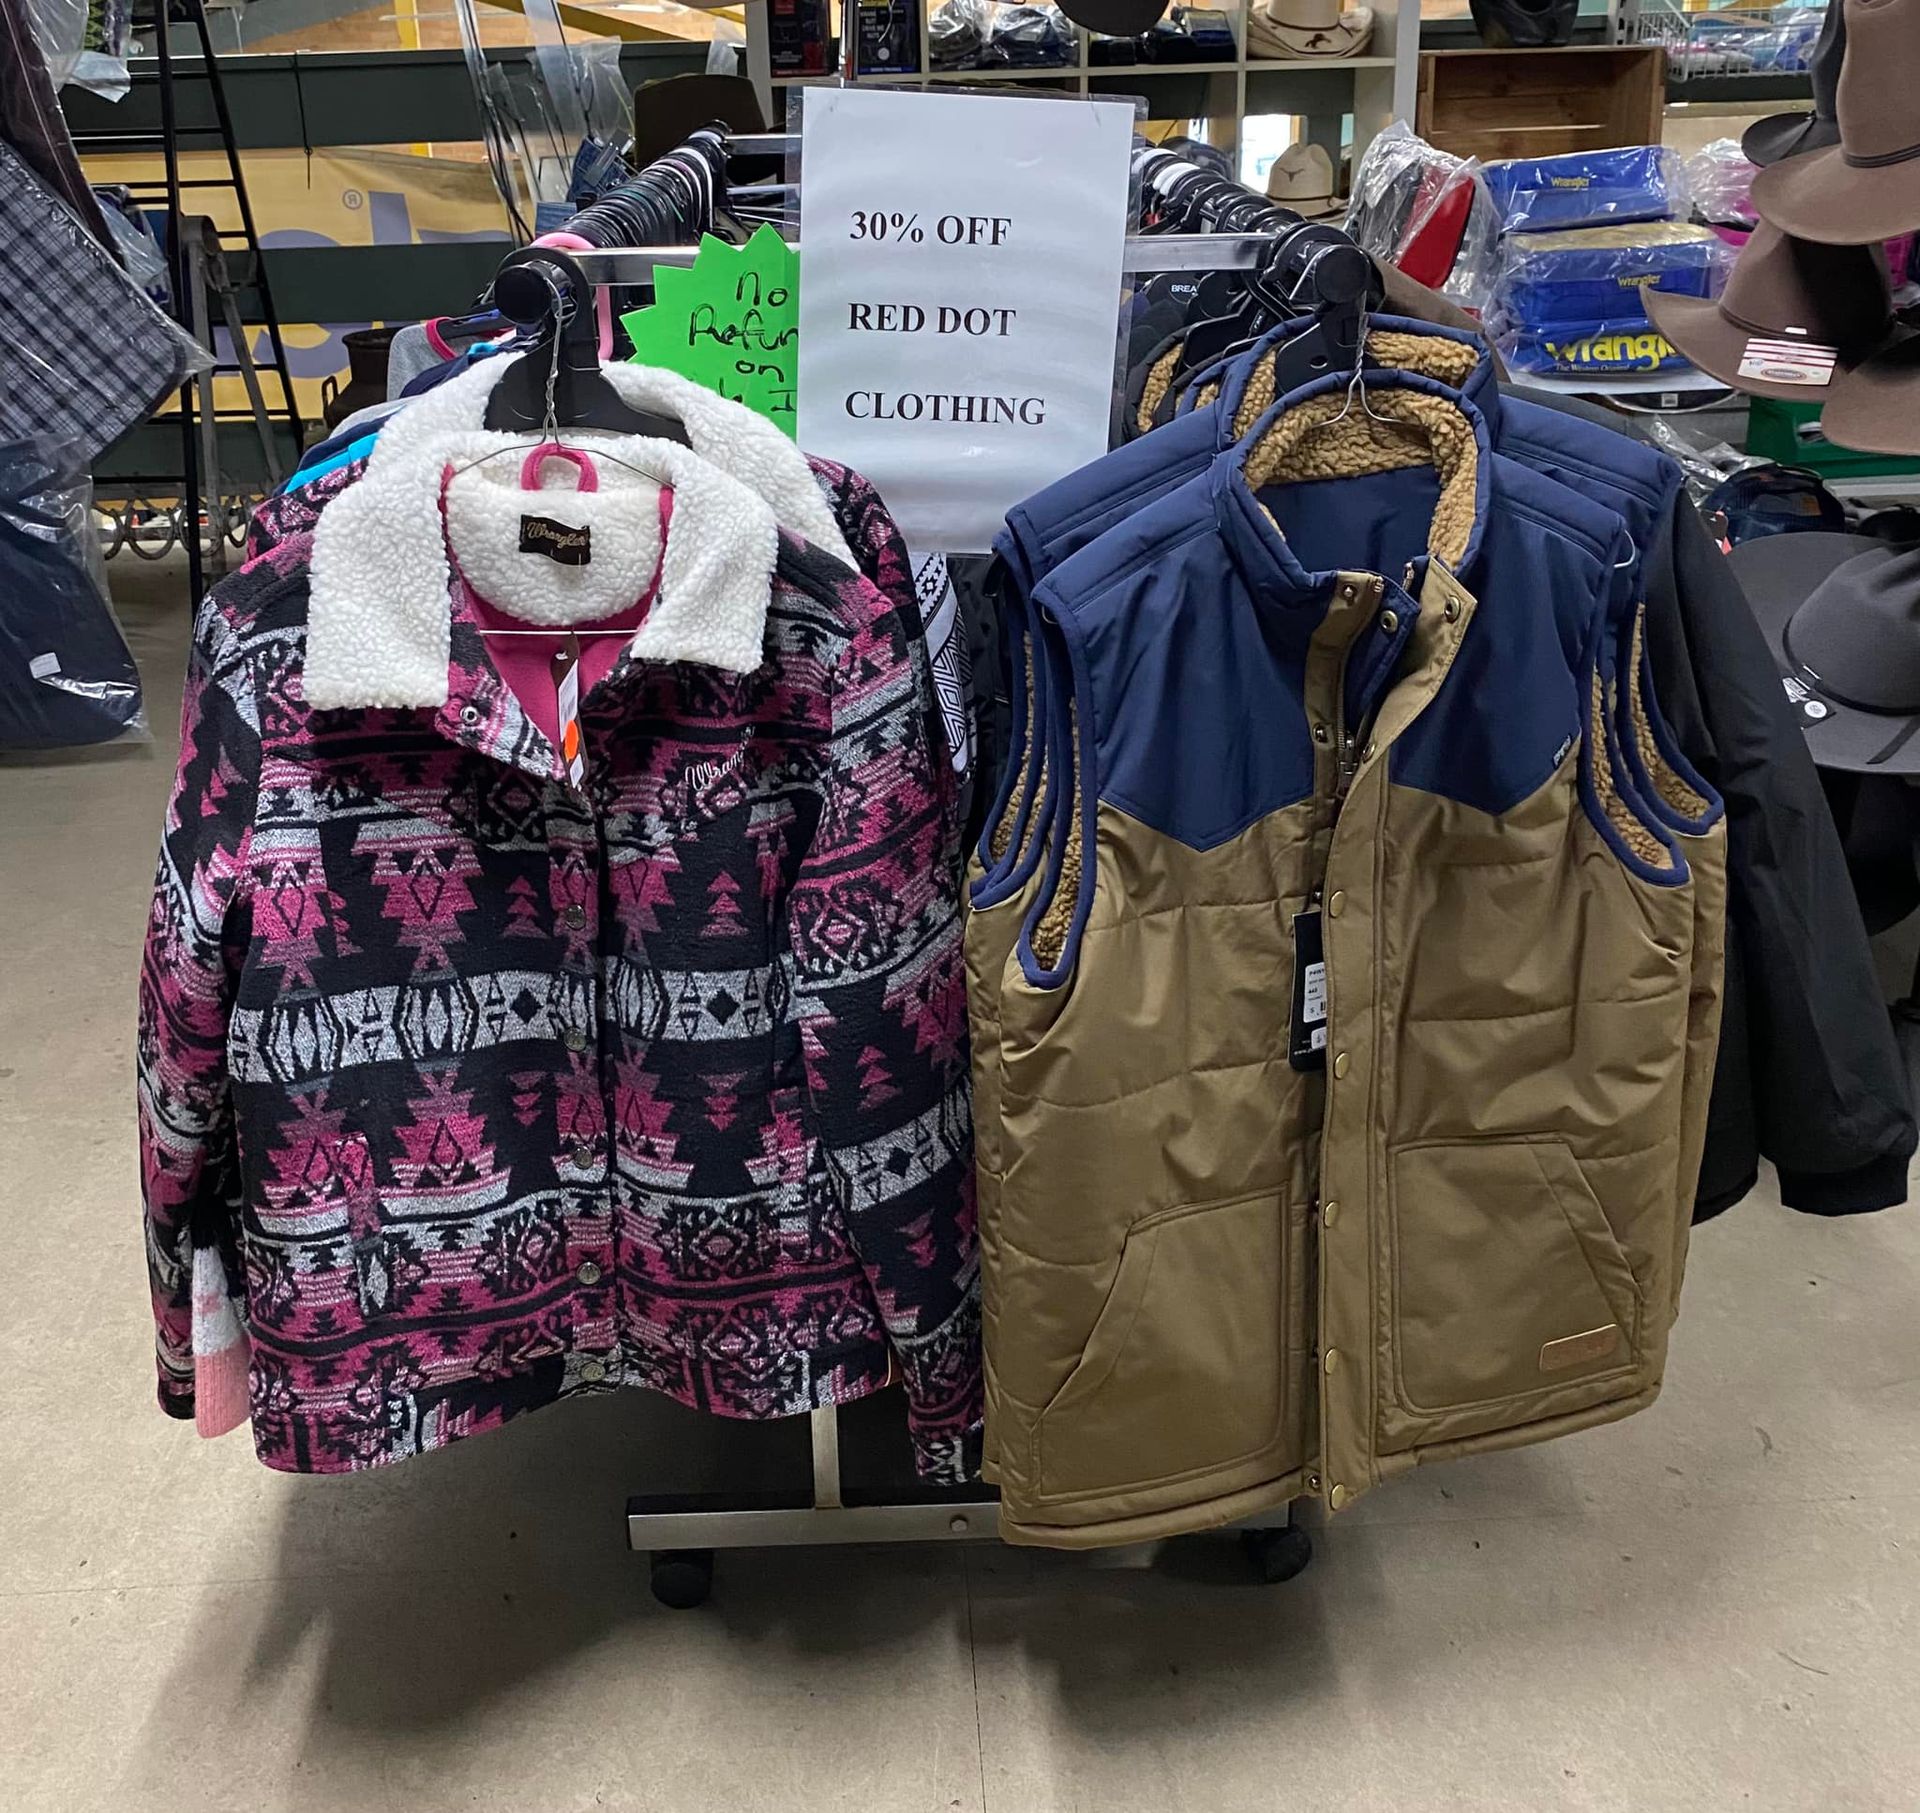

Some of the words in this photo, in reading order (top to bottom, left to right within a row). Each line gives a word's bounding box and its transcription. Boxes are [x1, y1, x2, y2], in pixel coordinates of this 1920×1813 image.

[849, 211, 924, 243] 30%
[937, 215, 1012, 246] OFF
[1171, 284, 1197, 293] BREA
[689, 303, 799, 351] Refun
[847, 303, 925, 332] RED
[936, 306, 1017, 337] DOT
[1545, 334, 1678, 372] Wrangl
[735, 360, 785, 383] on
[845, 391, 1046, 425] CLOTHING
[527, 521, 586, 549] Wrangler
[685, 726, 756, 791] Wran
